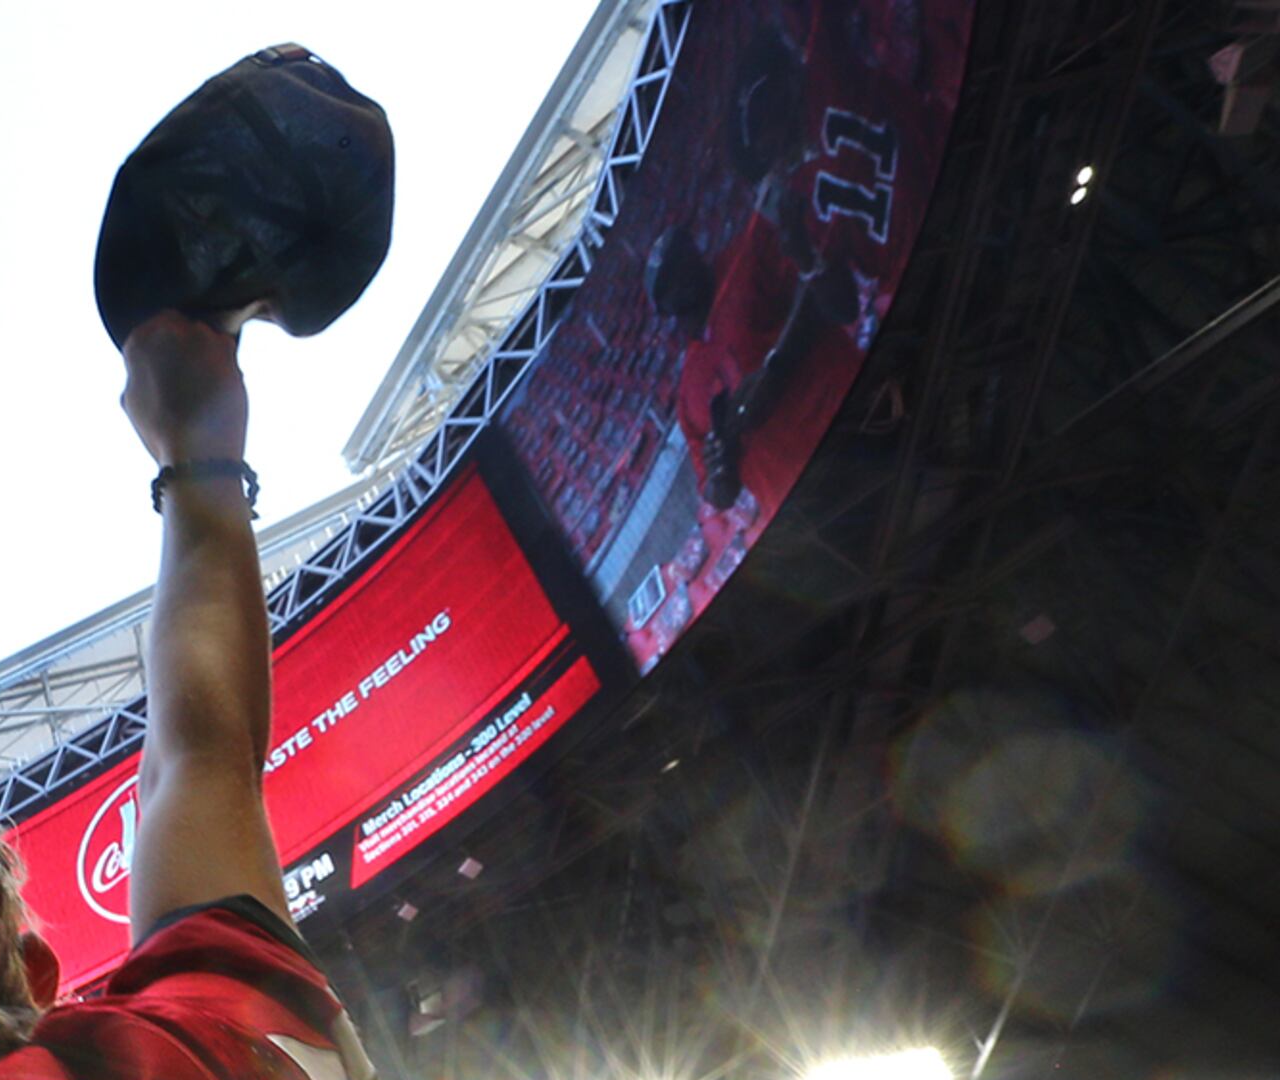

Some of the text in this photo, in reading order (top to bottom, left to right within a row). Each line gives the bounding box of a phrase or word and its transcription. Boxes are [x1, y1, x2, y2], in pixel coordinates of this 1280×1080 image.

[263, 612, 451, 773] ASTE THE FEELING
[361, 800, 405, 836] Merch
[402, 753, 466, 807] Locations
[471, 724, 498, 752] 300
[495, 691, 533, 731] Level
[300, 853, 335, 890] PM
